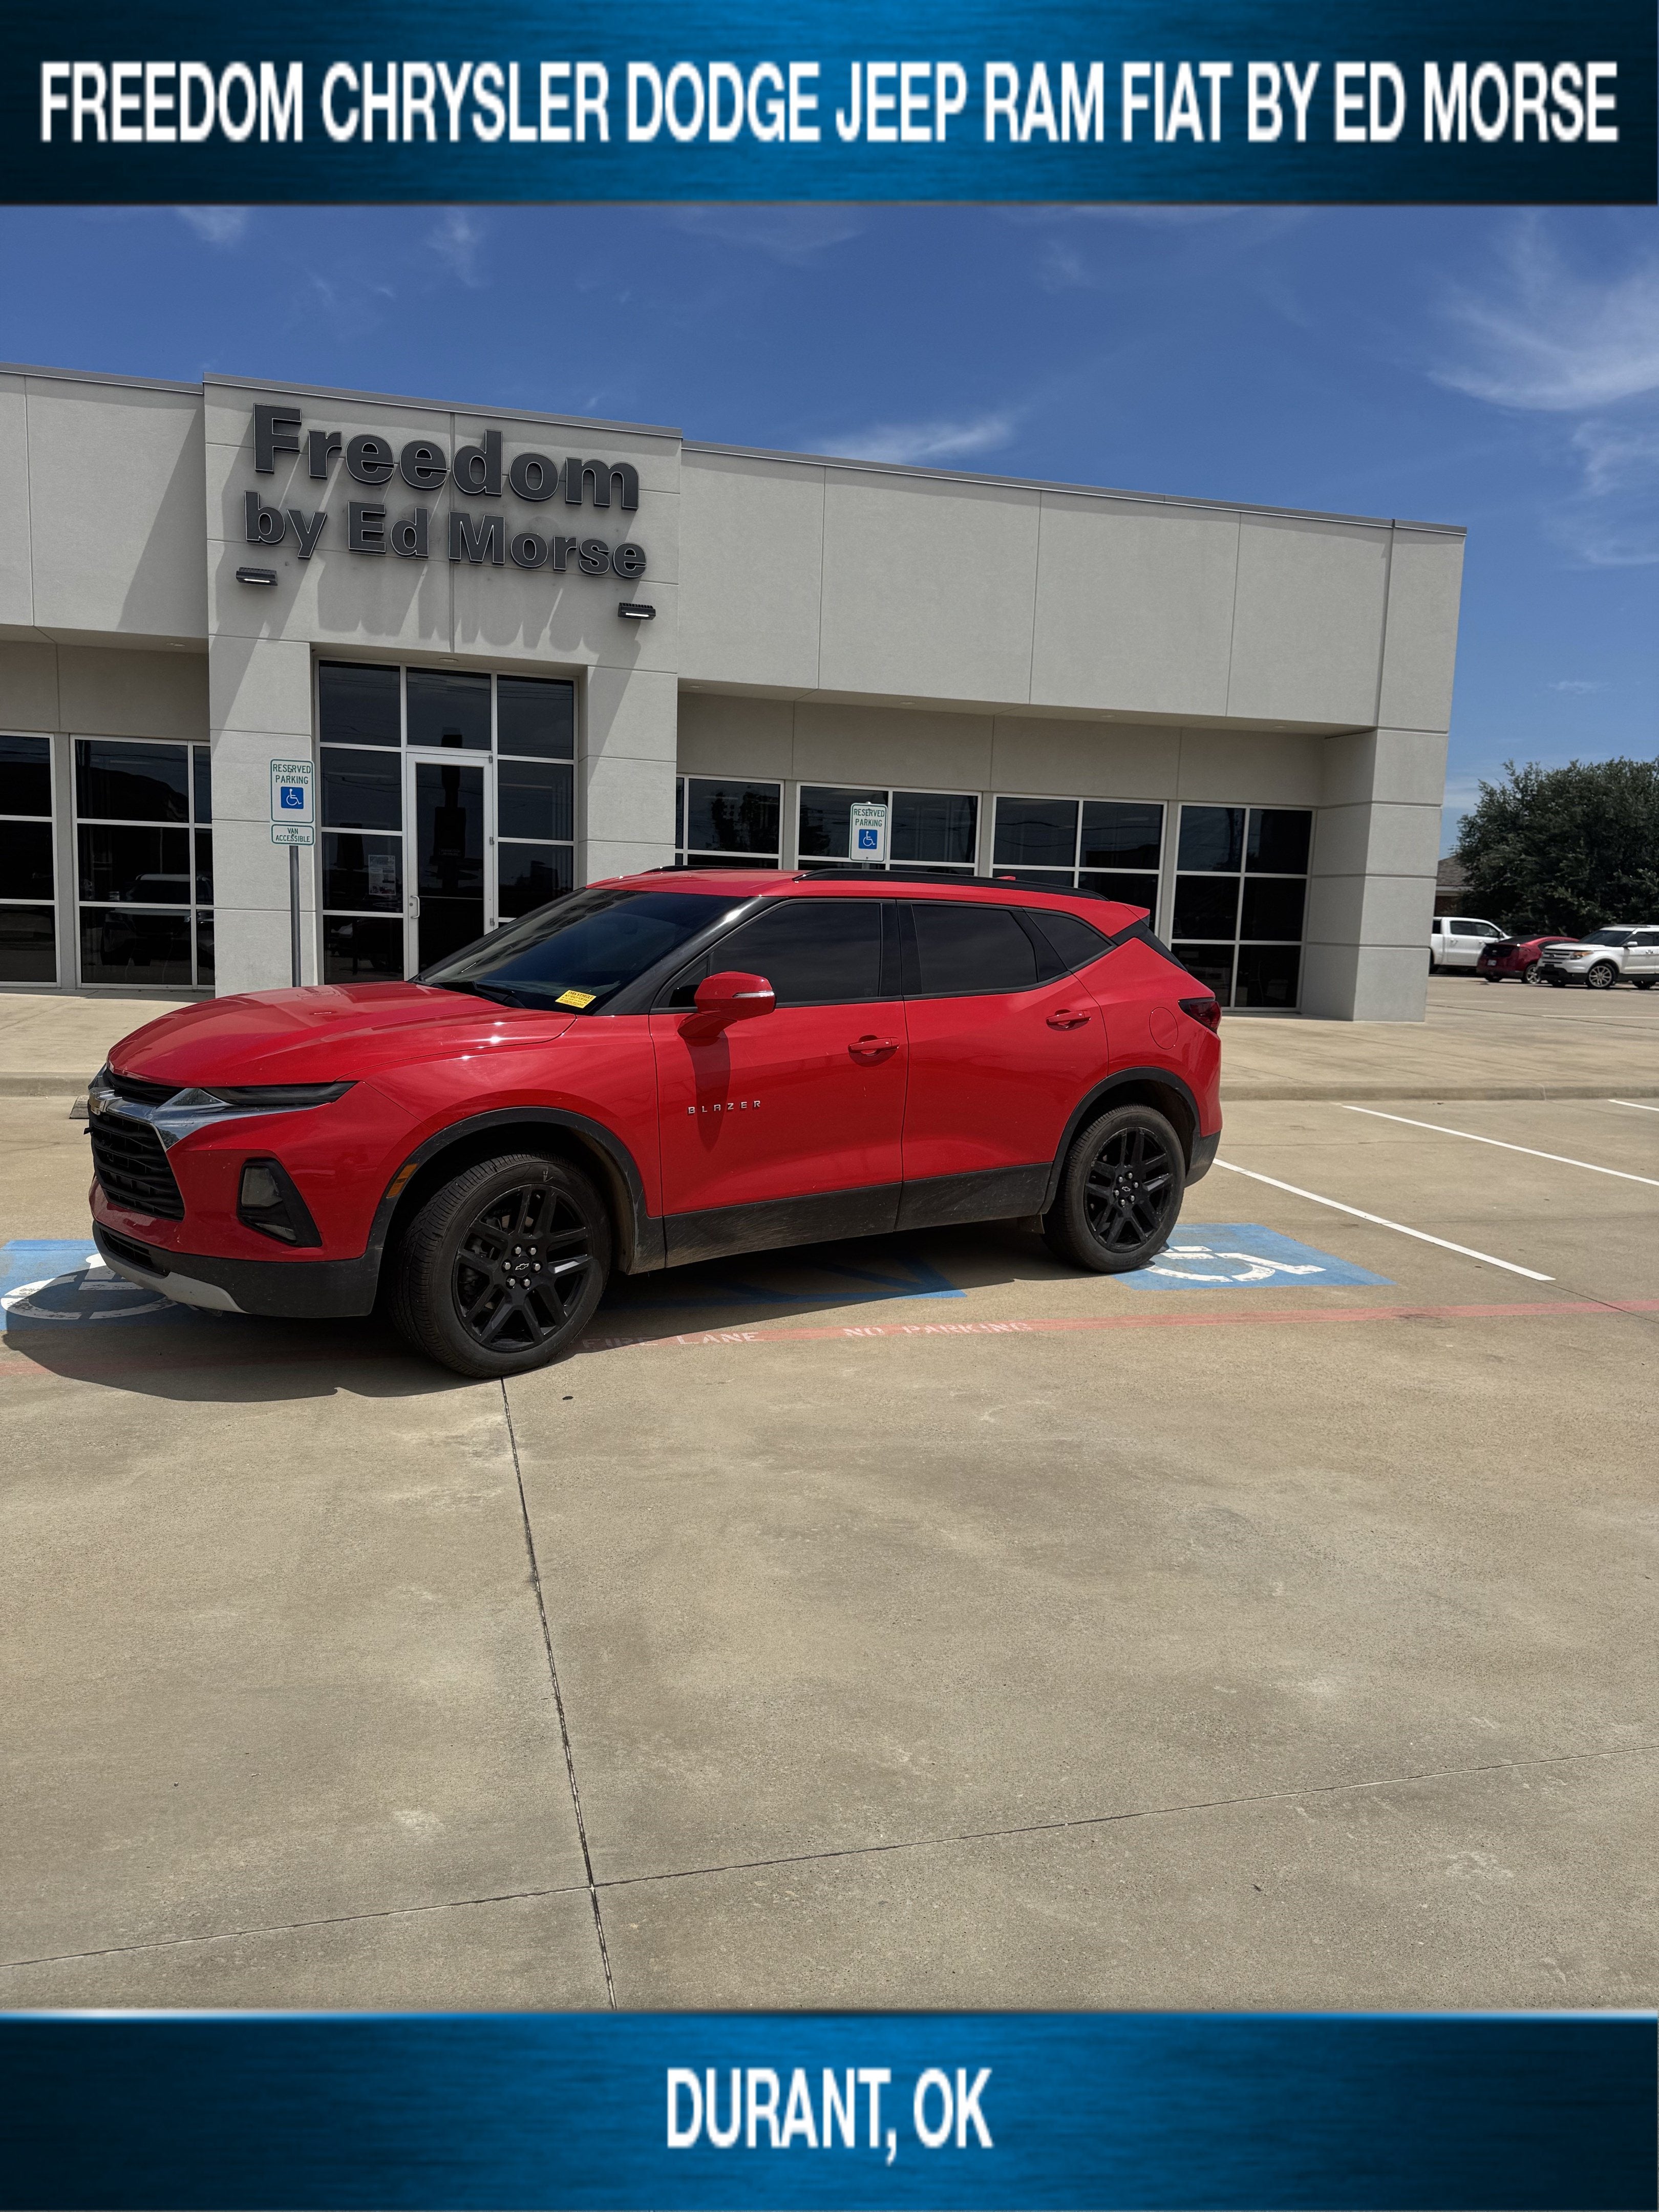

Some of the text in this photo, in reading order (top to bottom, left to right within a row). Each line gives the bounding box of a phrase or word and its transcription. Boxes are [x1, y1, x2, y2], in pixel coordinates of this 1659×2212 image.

[253, 402, 640, 511] Freedom
[244, 490, 647, 579] by Ed Morse
[273, 764, 311, 774] RESERVED
[275, 775, 308, 784] PARKING
[854, 809, 885, 817] RESERVED
[855, 819, 882, 827] PARKING
[688, 1100, 761, 1114] BLAZER
[842, 1322, 1033, 1337] NO PARKING
[582, 1332, 764, 1349] FIRE LANE
